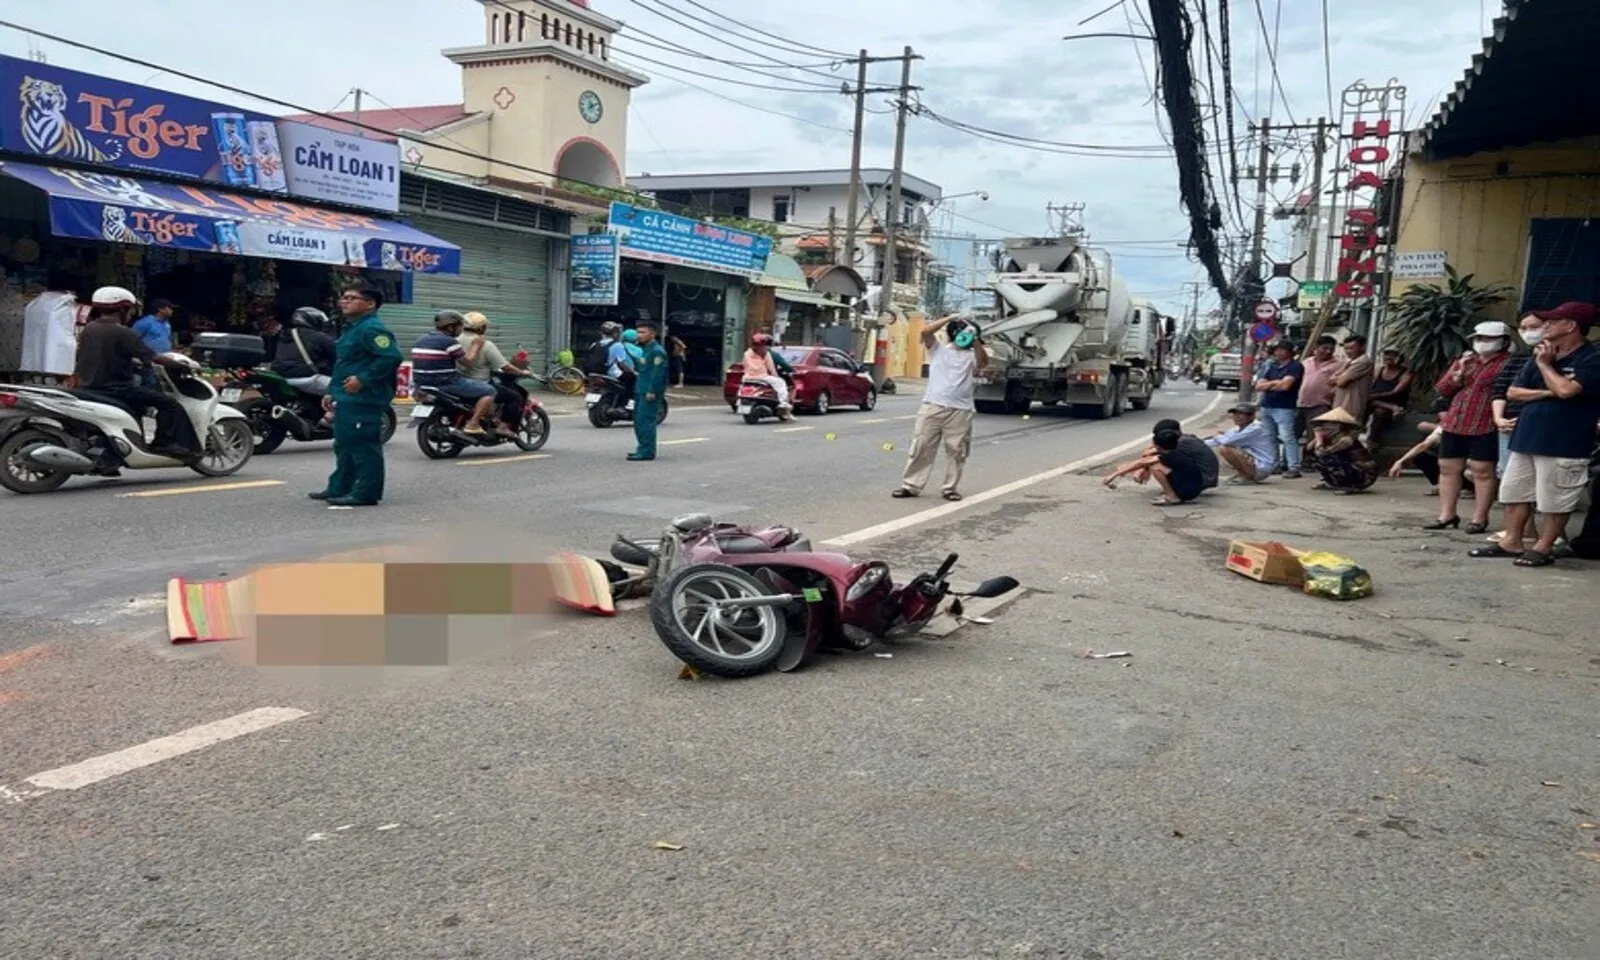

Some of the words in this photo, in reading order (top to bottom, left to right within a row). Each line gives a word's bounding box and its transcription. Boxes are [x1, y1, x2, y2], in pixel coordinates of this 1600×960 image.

[78, 92, 208, 159] Tiger
[295, 141, 334, 171] CẨM
[339, 155, 384, 181] LOAN
[387, 165, 395, 183] 1
[130, 210, 199, 244] Tiger
[292, 236, 319, 249] LOAN
[321, 240, 326, 250] 1
[400, 245, 442, 270] Tiger
